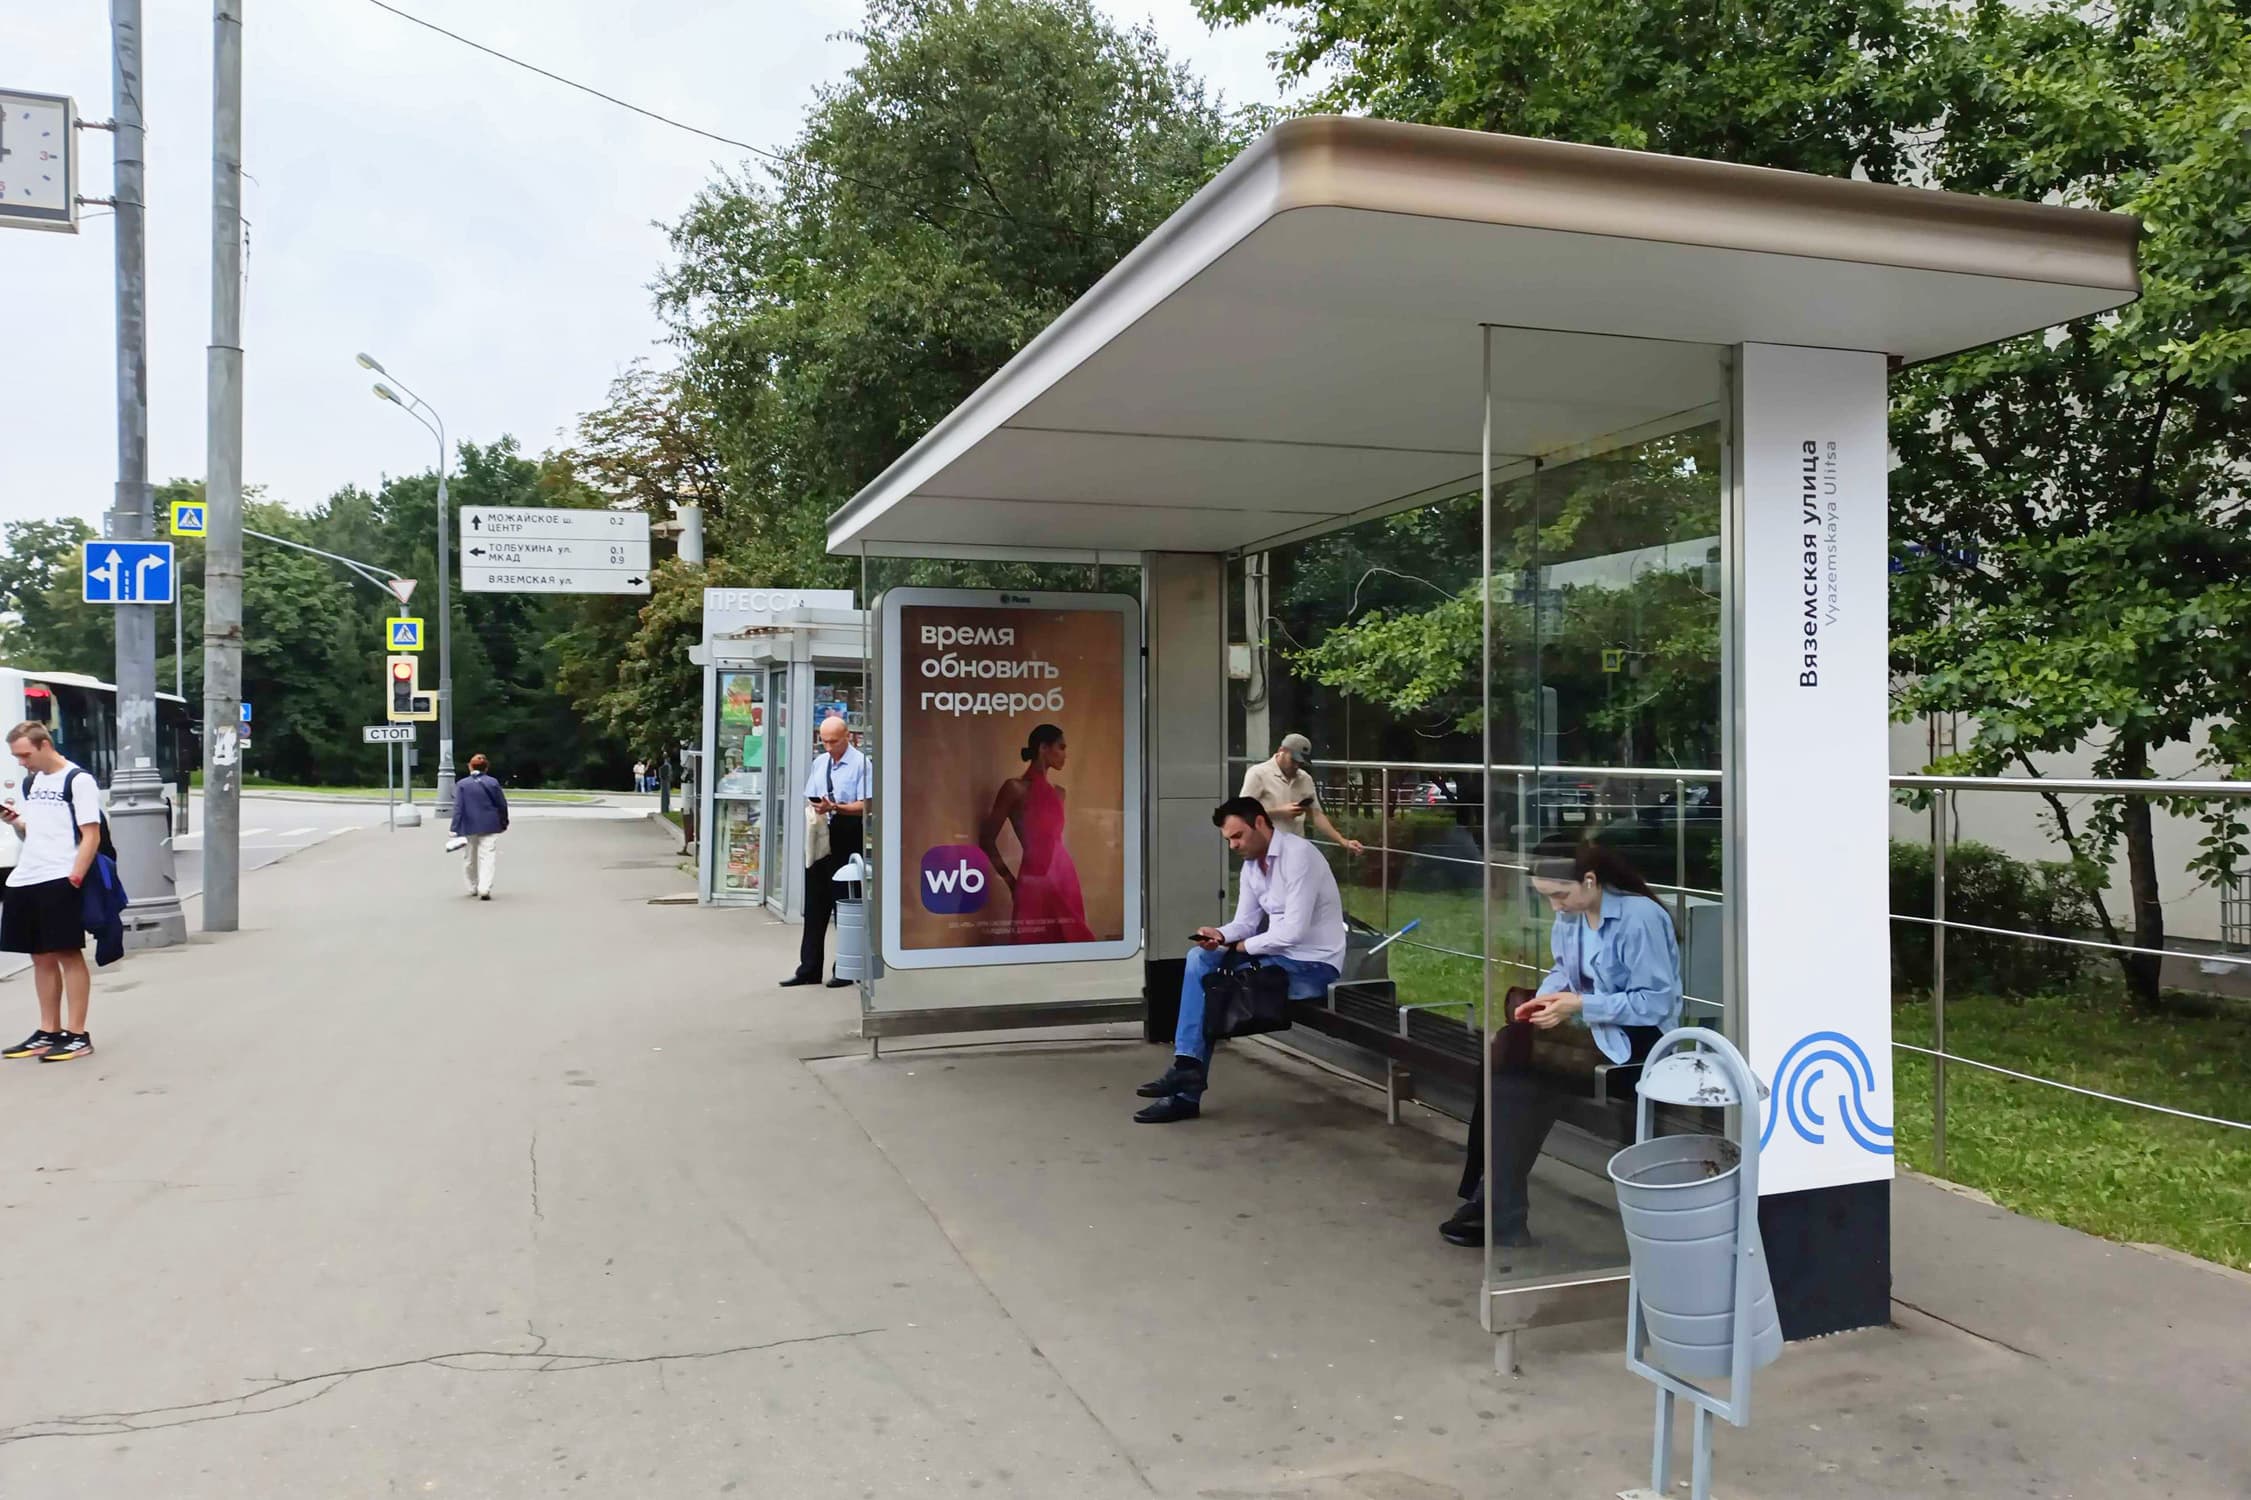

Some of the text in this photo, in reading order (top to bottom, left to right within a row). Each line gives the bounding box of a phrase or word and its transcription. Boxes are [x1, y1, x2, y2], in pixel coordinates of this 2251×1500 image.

[40, 151, 48, 161] 3
[488, 512, 559, 524] МОЖАЙСКОЕ
[610, 517, 625, 526] 0.2
[488, 524, 523, 533] ЦЕНТР
[1824, 441, 1840, 626] Vyazemskaya Ulitsa
[489, 543, 624, 556] ТОЛБУХИНА ул. 0.1
[489, 553, 625, 565] МКАД 0.9
[1800, 440, 1821, 687] Вяземская улица
[488, 575, 573, 586] ВЯЗЕМСКАЯ ул.
[709, 591, 800, 612] ПРЕССА
[921, 625, 1015, 651] время
[920, 652, 1060, 679] обновить
[921, 687, 1065, 717] гардероб
[370, 728, 409, 740] СТОП
[924, 859, 985, 894] wb
